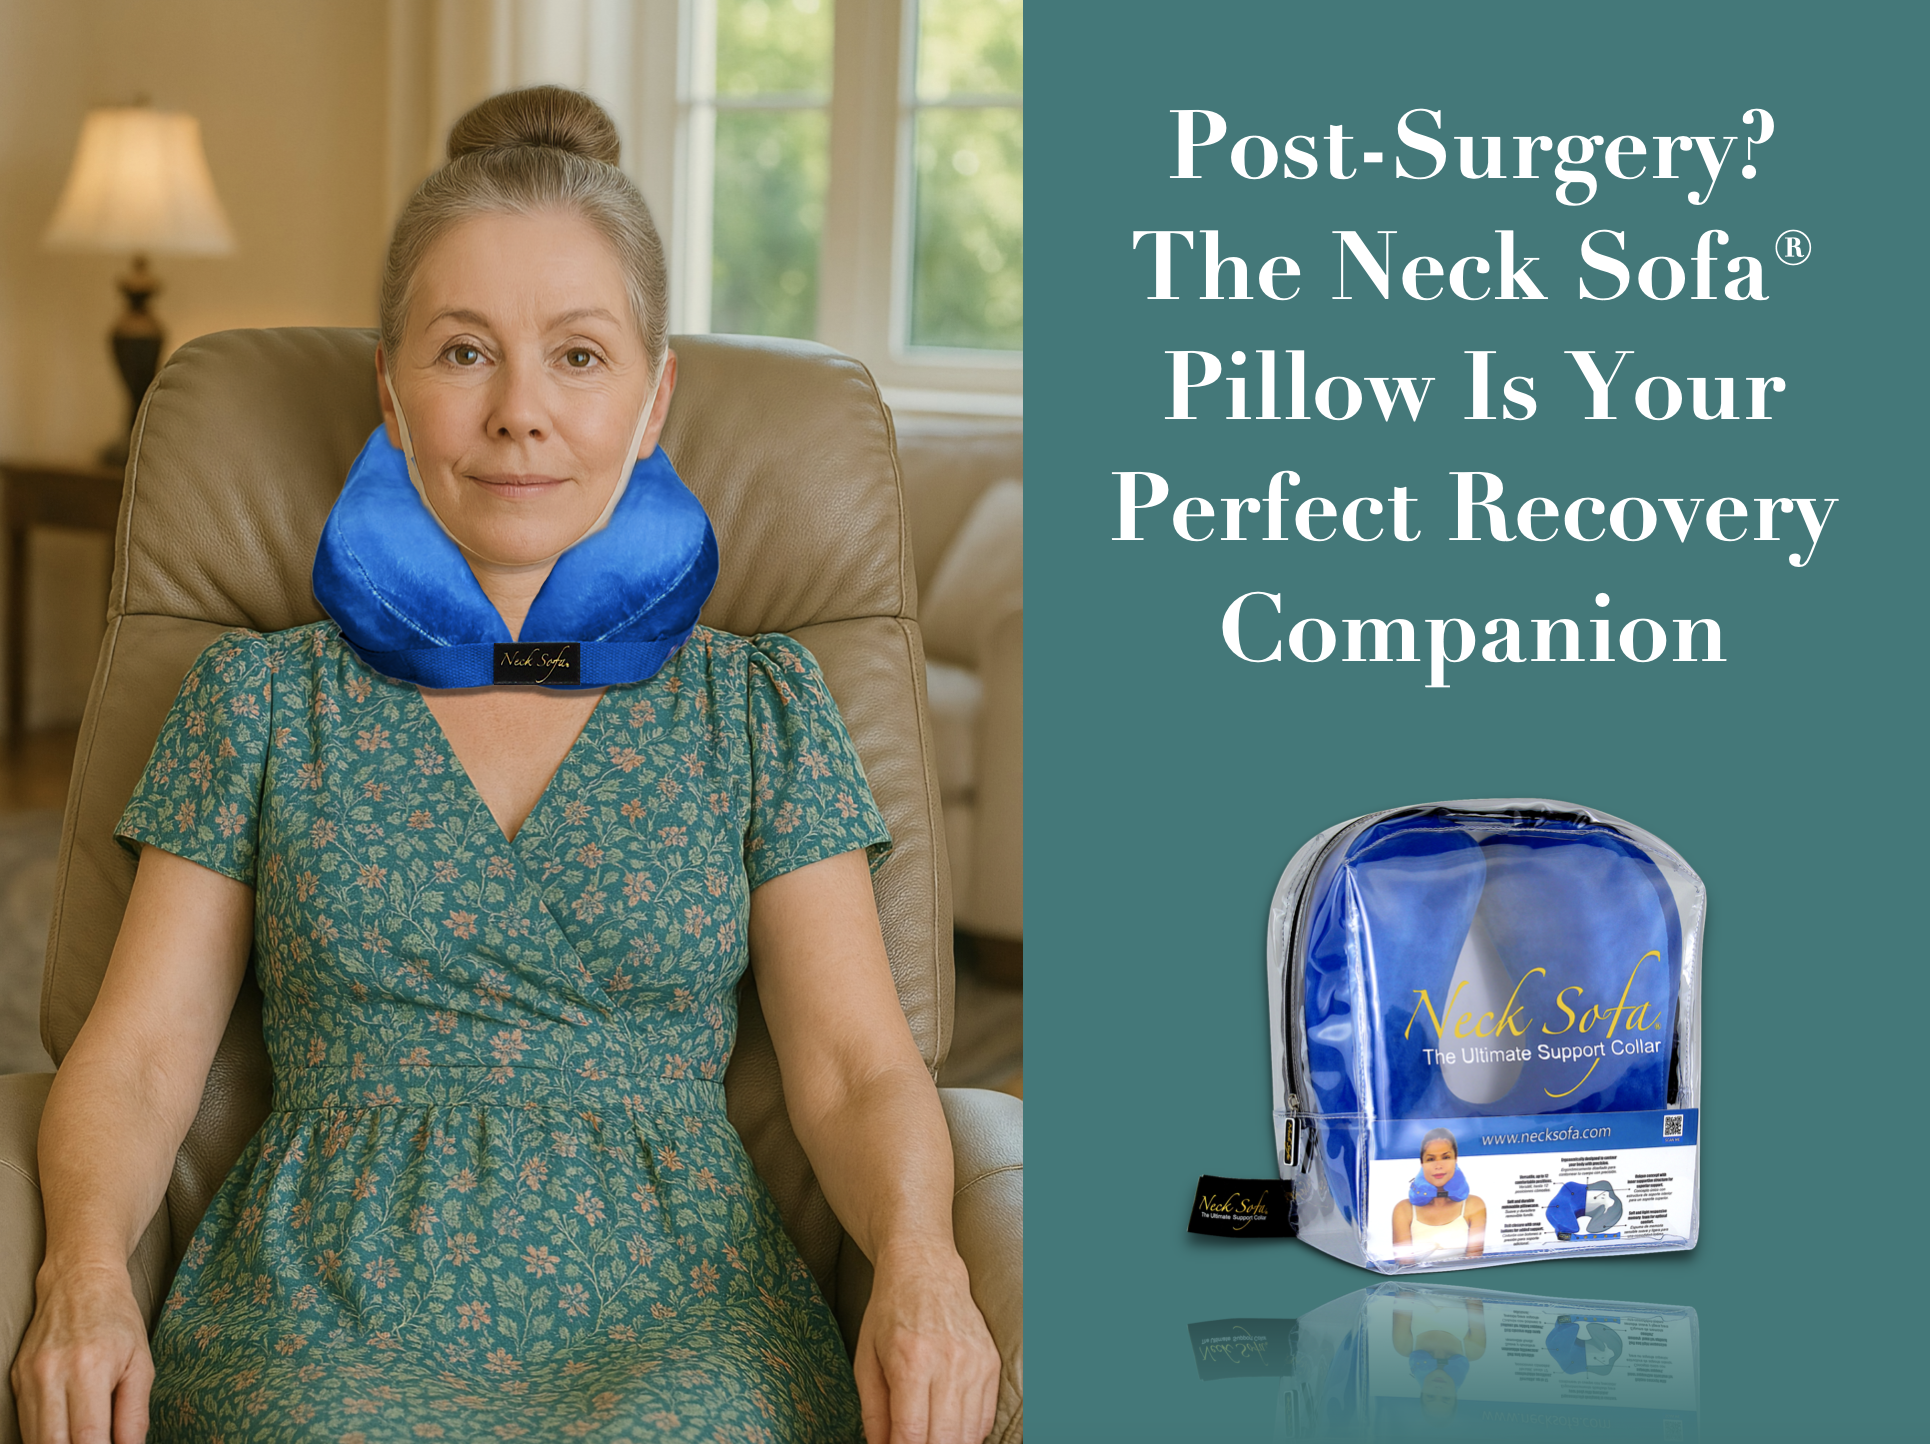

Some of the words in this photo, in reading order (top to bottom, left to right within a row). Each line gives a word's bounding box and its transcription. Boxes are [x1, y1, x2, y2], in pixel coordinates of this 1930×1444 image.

[501, 648, 540, 667] Neck
[1404, 966, 1546, 1040] Neck
[1422, 1048, 1456, 1065] The
[1461, 1045, 1532, 1064] Ultimate
[1537, 1042, 1606, 1063] Support
[1611, 1038, 1662, 1056] Collar
[1482, 1125, 1612, 1146] www.necksofa.com
[1199, 1192, 1240, 1213] Neck
[1210, 1212, 1231, 1220] Ultimate
